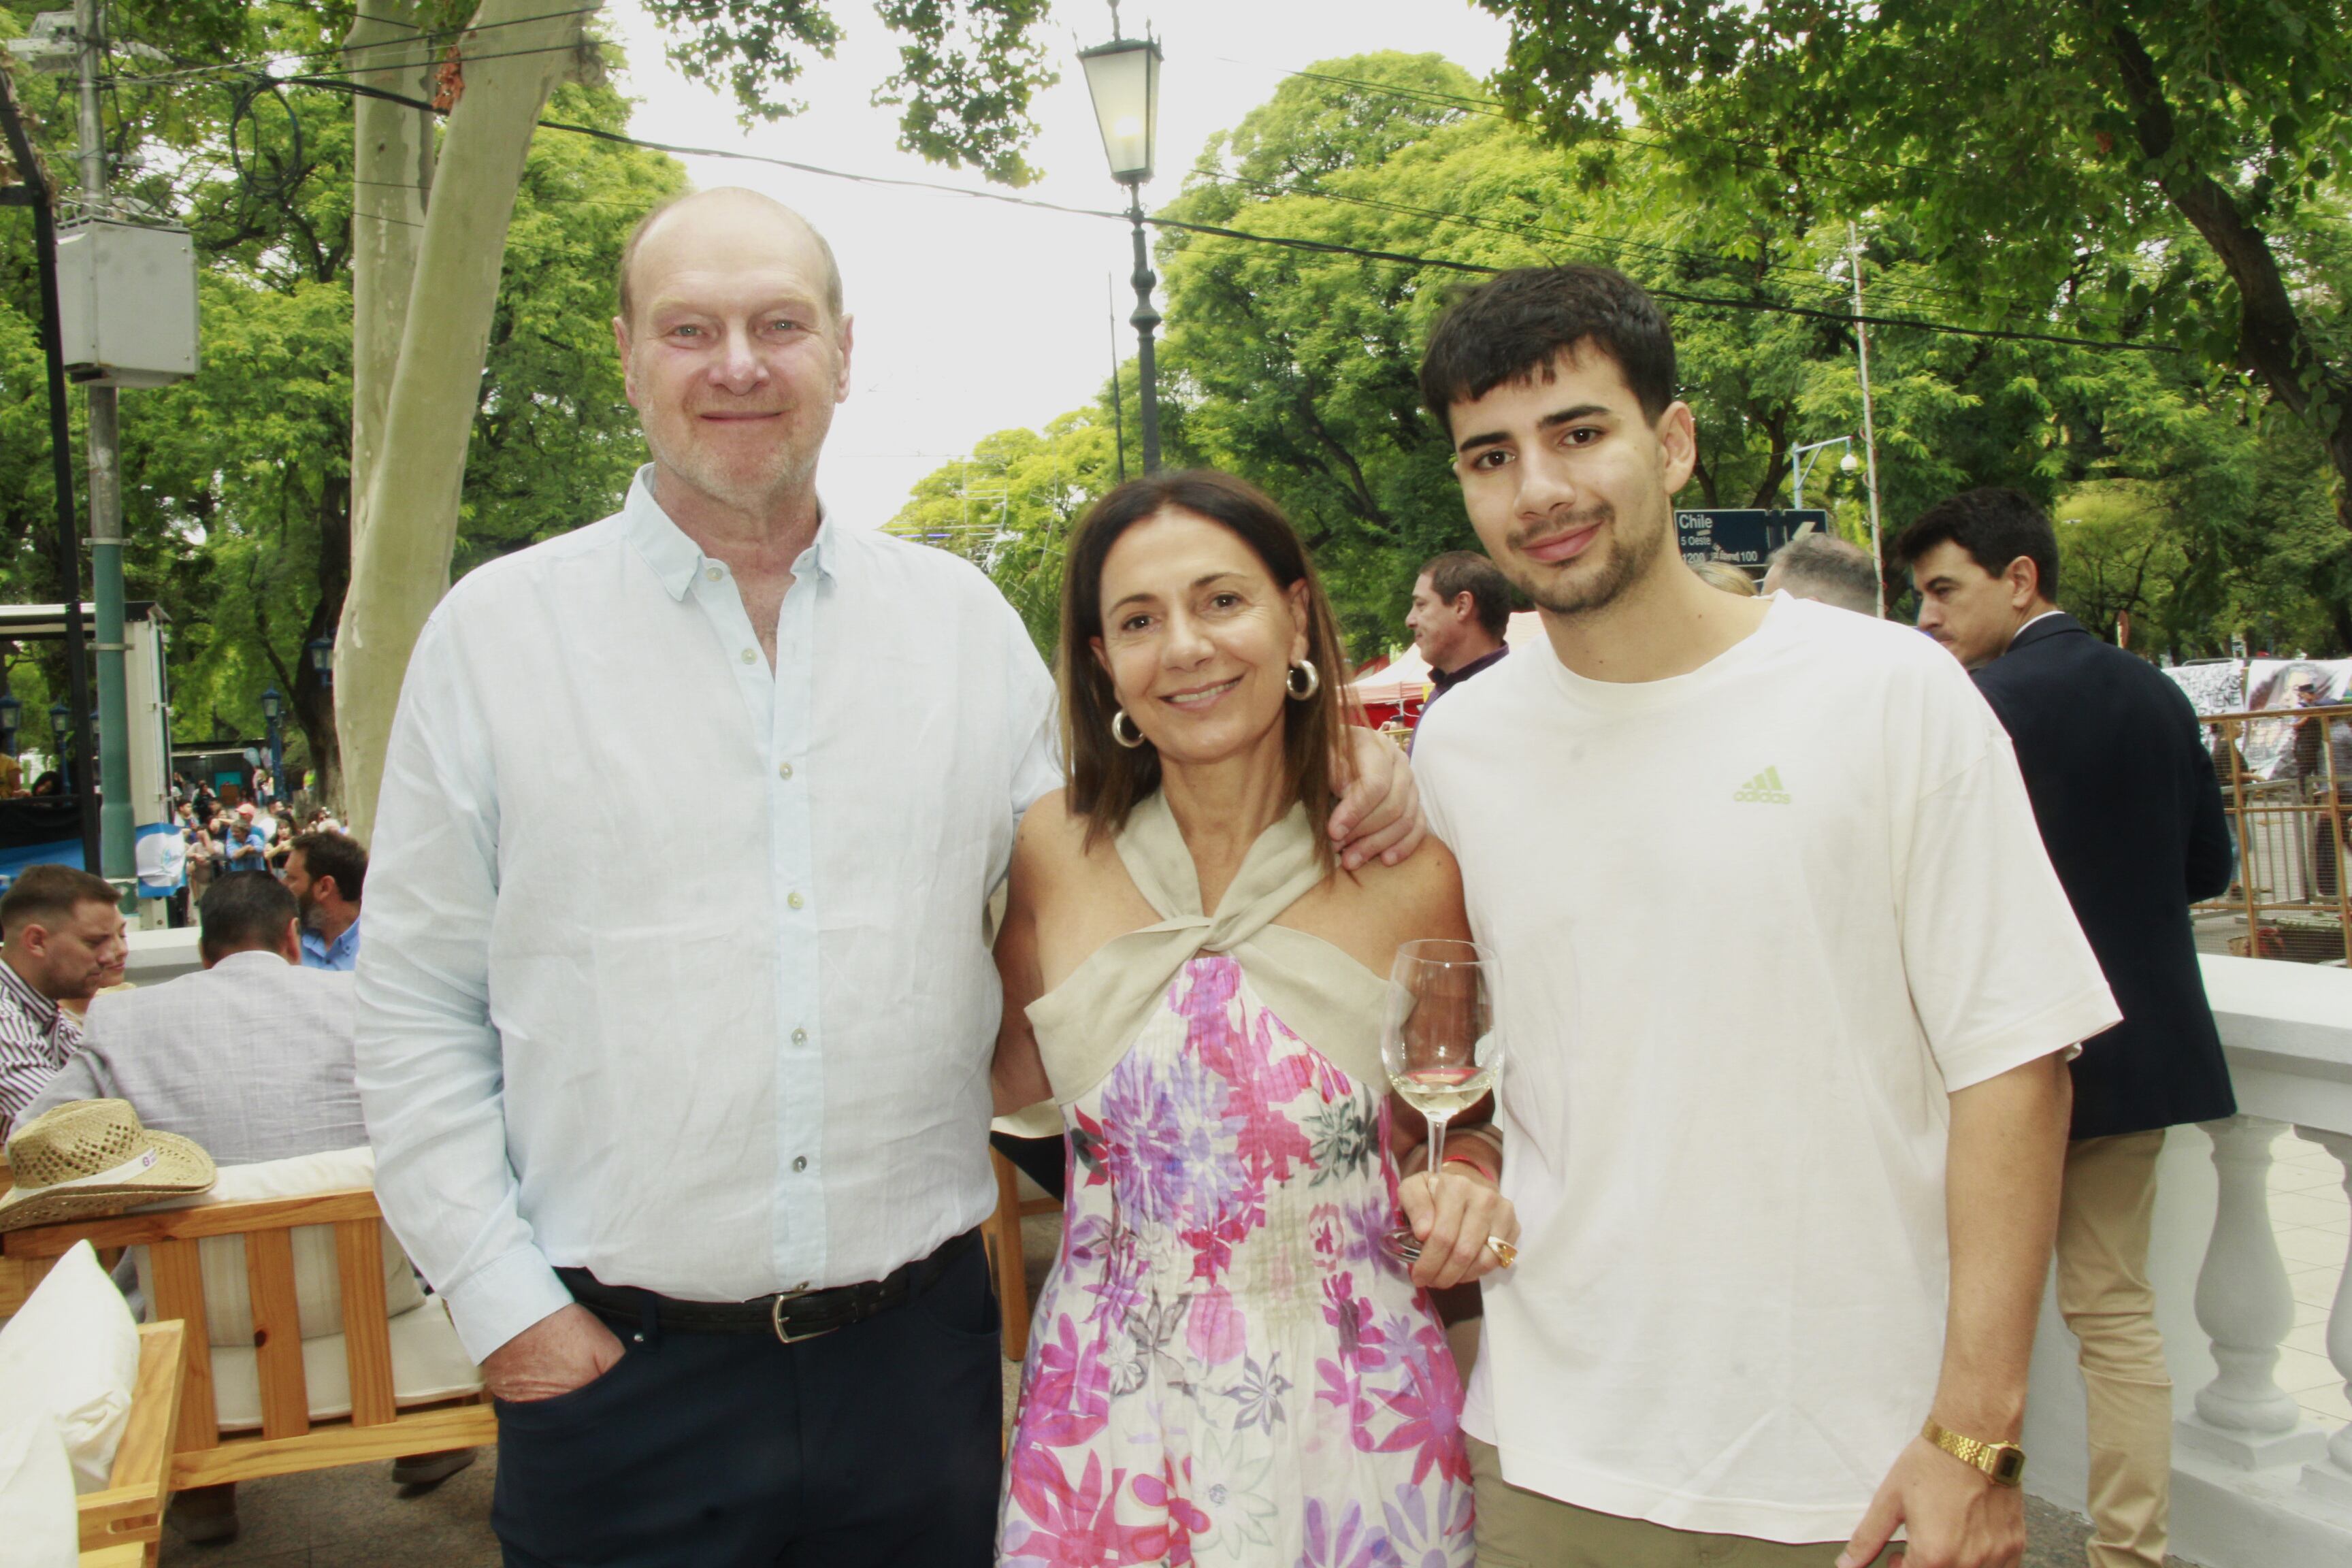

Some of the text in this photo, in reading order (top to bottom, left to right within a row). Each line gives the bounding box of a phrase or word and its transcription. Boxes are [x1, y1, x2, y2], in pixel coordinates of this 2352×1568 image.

[1679, 514, 1713, 529] Chile
[1681, 536, 1711, 546] 5 Oeste
